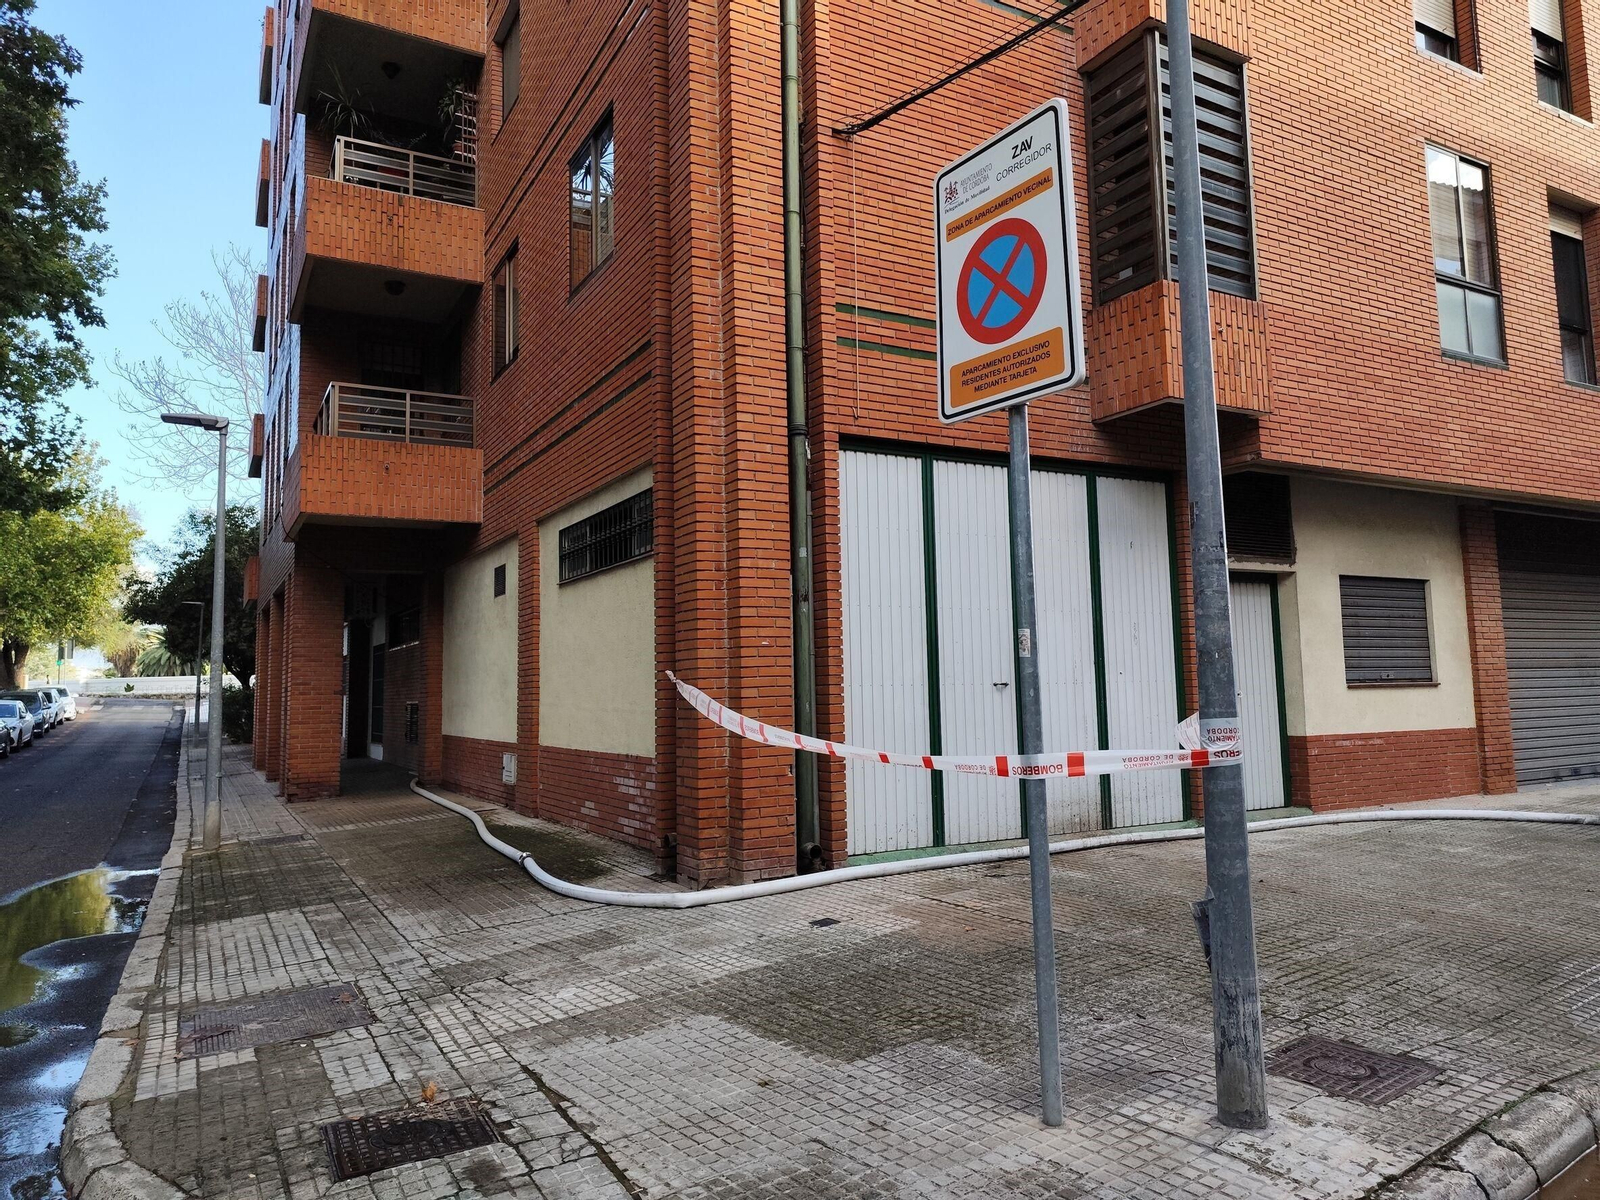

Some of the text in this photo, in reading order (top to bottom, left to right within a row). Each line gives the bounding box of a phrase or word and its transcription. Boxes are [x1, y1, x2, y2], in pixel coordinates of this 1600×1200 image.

[995, 142, 1052, 182] CORREGIDOR
[1011, 136, 1033, 160] ZAV
[962, 185, 968, 194] DE
[947, 176, 1051, 236] ZONA DE APARCAMIENTO VECINAL
[961, 340, 1050, 378] APARCAMIENTO EXCLUSIVO
[961, 350, 1051, 387] RESIDENTES AUTORIZADOS
[973, 366, 1038, 393] MEDIANTE TARJETA
[1012, 763, 1063, 776] BOMBEROS
